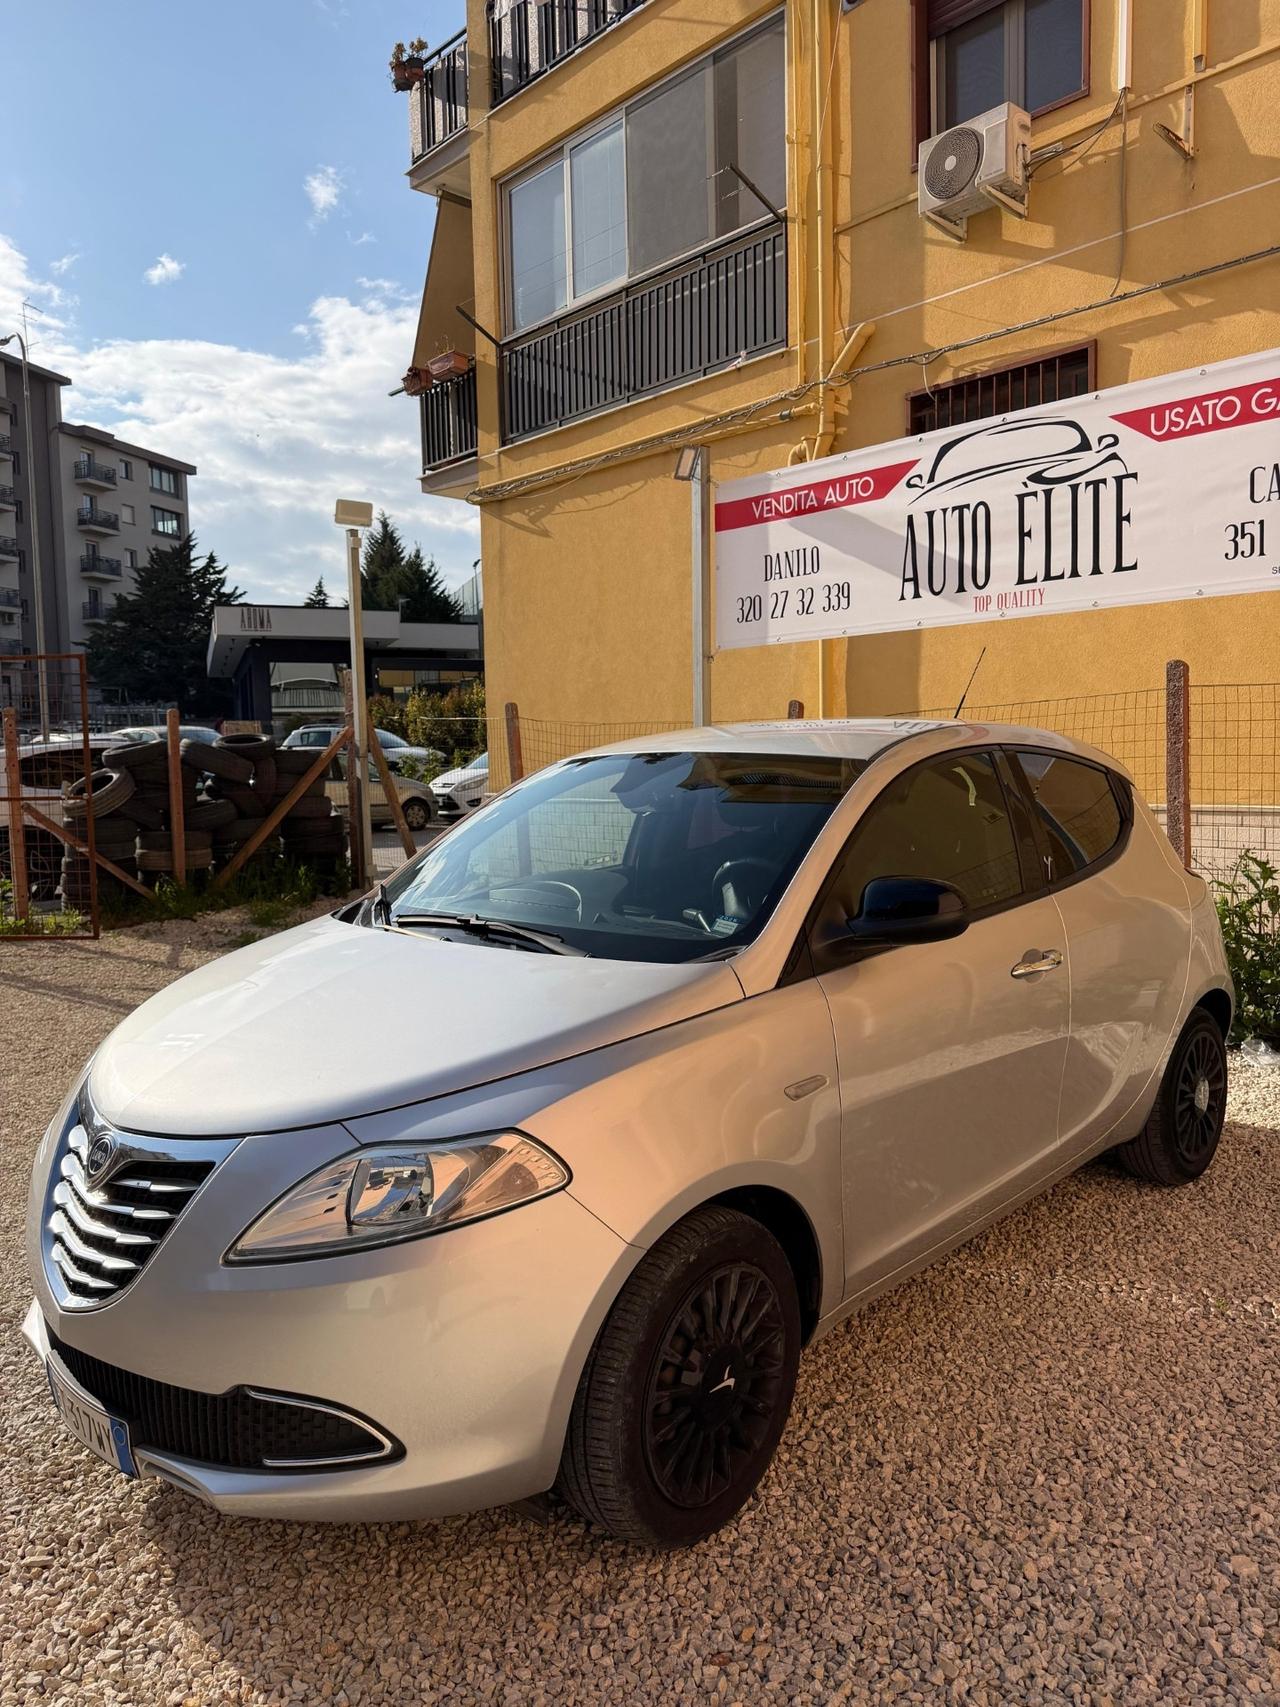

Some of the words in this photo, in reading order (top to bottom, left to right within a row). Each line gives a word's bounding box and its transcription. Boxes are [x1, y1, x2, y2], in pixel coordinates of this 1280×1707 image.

[1150, 395, 1242, 436] USATO
[1251, 387, 1280, 415] G
[751, 489, 818, 520] VENDITA
[824, 476, 874, 503] AUTO
[898, 500, 992, 602] AUTO
[1224, 519, 1265, 561] 351
[764, 546, 821, 583] DANILO
[736, 593, 762, 624] 320
[770, 590, 789, 620] 27
[796, 587, 815, 615] 32
[822, 581, 851, 613] 339
[973, 595, 992, 613] TOP
[997, 587, 1046, 610] QUALITY
